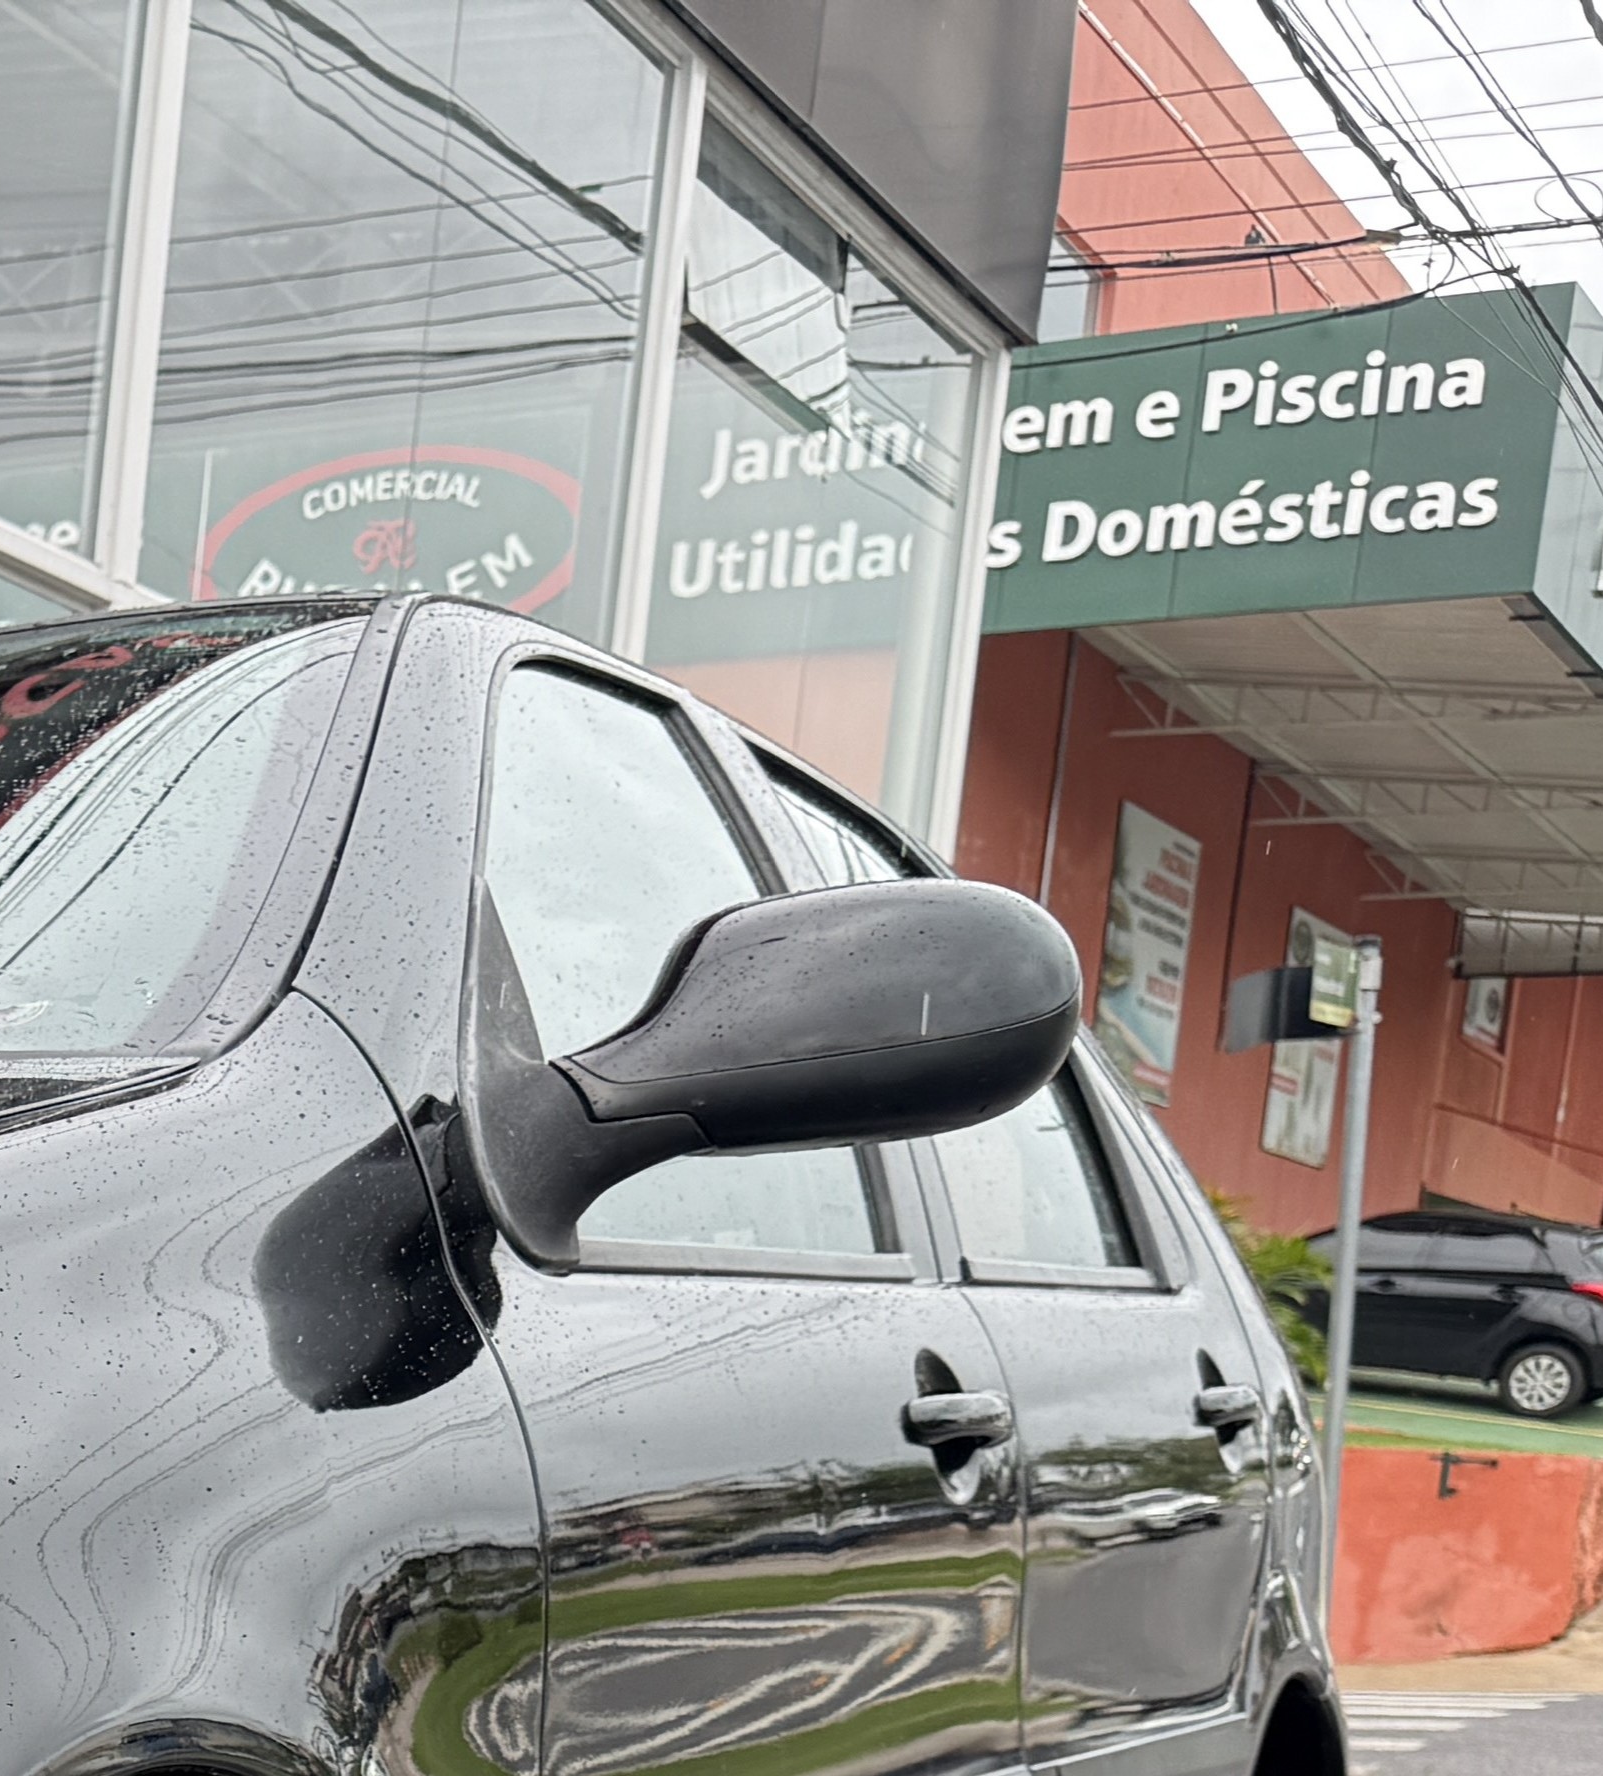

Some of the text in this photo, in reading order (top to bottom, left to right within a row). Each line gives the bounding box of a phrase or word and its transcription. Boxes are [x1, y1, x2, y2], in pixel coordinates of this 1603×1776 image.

[1135, 389, 1181, 440] e
[1200, 348, 1487, 433] Piscina
[301, 469, 482, 520] COMERCIAL
[1041, 469, 1501, 563] Domésticas
